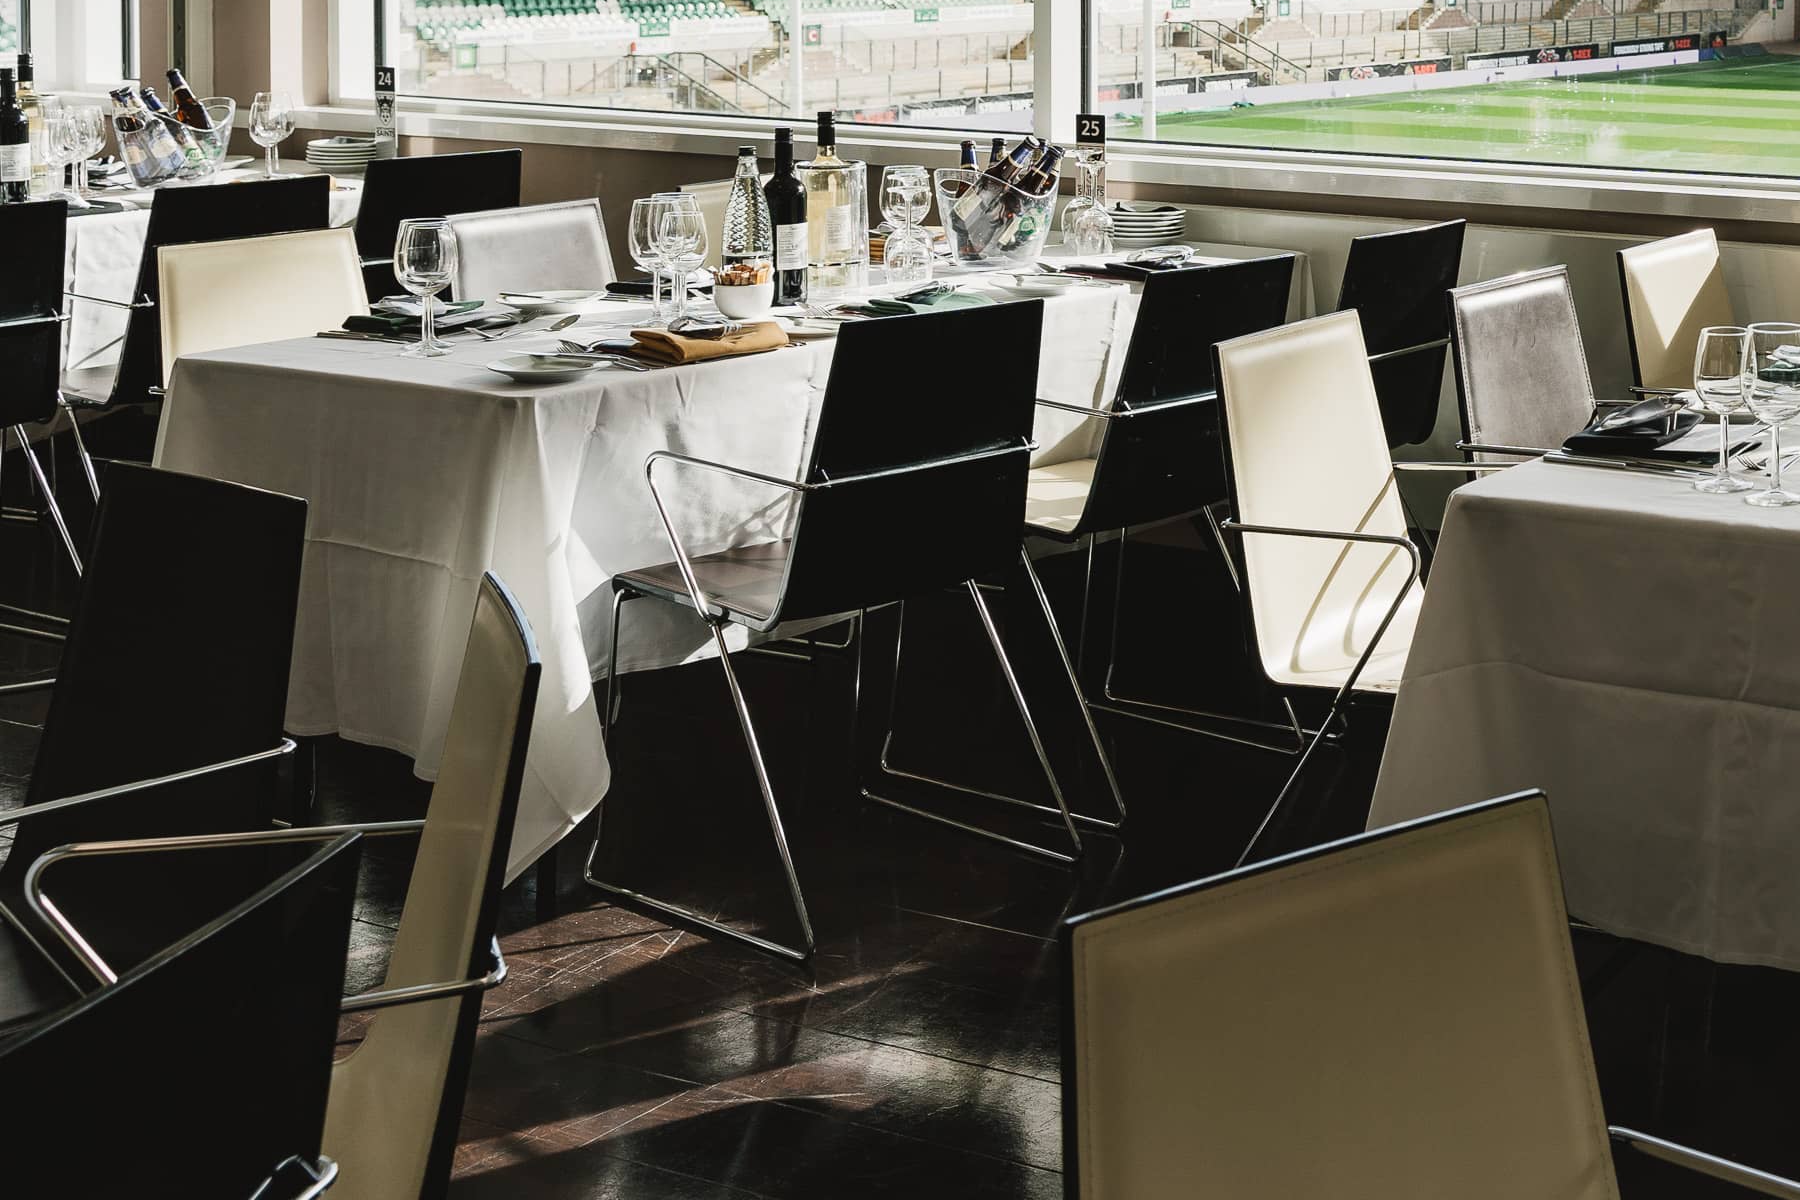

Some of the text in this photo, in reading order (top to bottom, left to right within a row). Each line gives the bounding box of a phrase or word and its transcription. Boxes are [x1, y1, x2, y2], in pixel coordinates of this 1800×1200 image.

[378, 72, 392, 86] 24
[375, 129, 395, 138] SAINTS
[1081, 119, 1100, 136] 25
